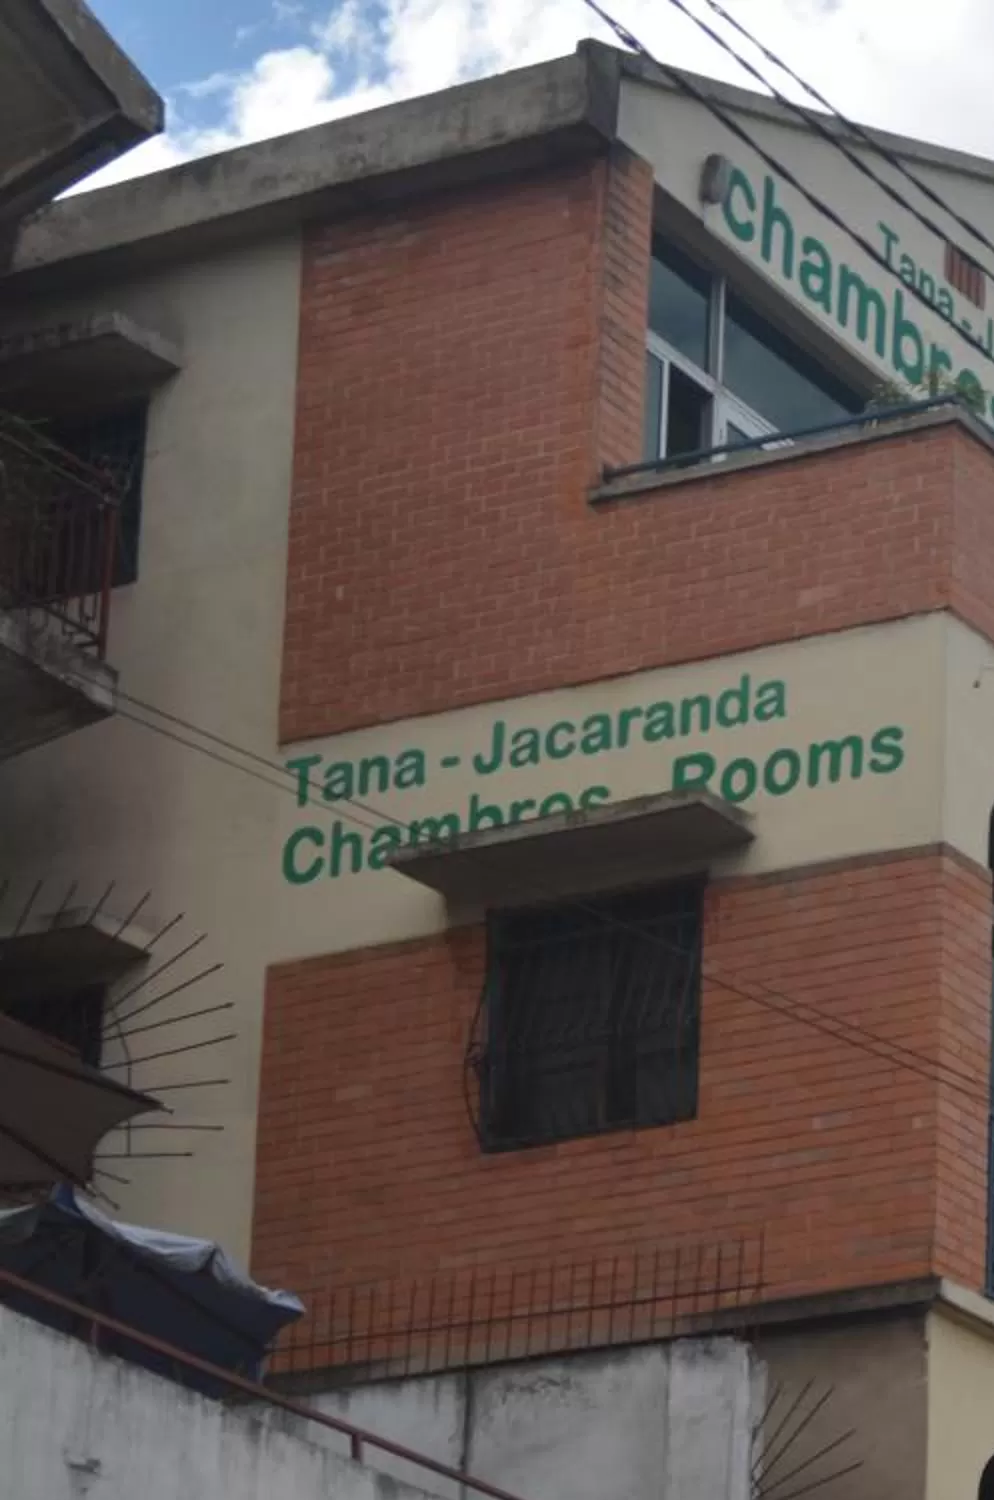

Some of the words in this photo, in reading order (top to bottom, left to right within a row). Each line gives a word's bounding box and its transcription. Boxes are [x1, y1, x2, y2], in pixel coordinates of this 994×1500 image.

[876, 221, 955, 321] Tana
[286, 749, 427, 805] Tana
[472, 674, 787, 776] Jacaranda
[670, 725, 906, 803] Rooms
